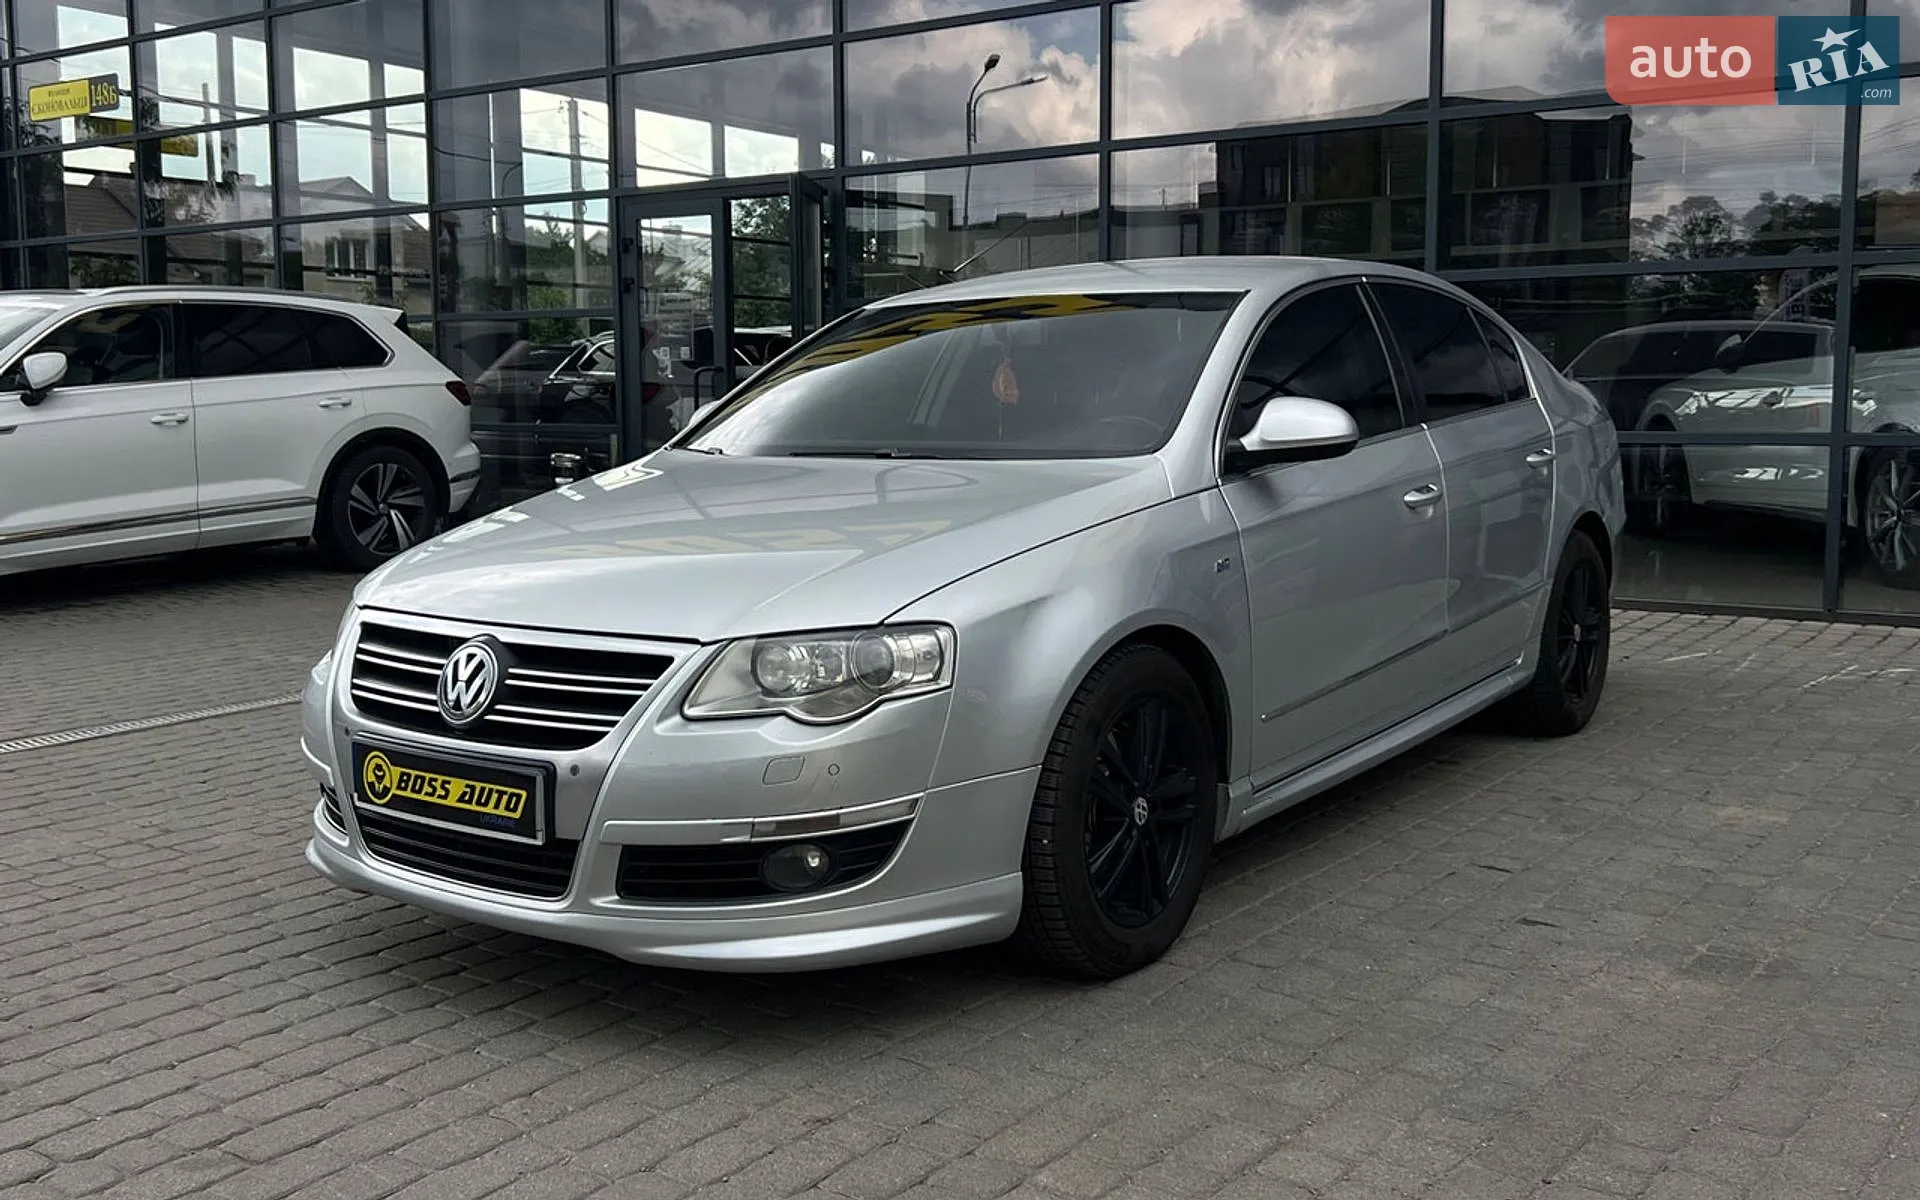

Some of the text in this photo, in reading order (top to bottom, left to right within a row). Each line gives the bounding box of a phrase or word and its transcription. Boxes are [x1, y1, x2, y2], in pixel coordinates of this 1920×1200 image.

[442, 645, 493, 717] VW
[396, 771, 522, 813] BOSS AUTO
